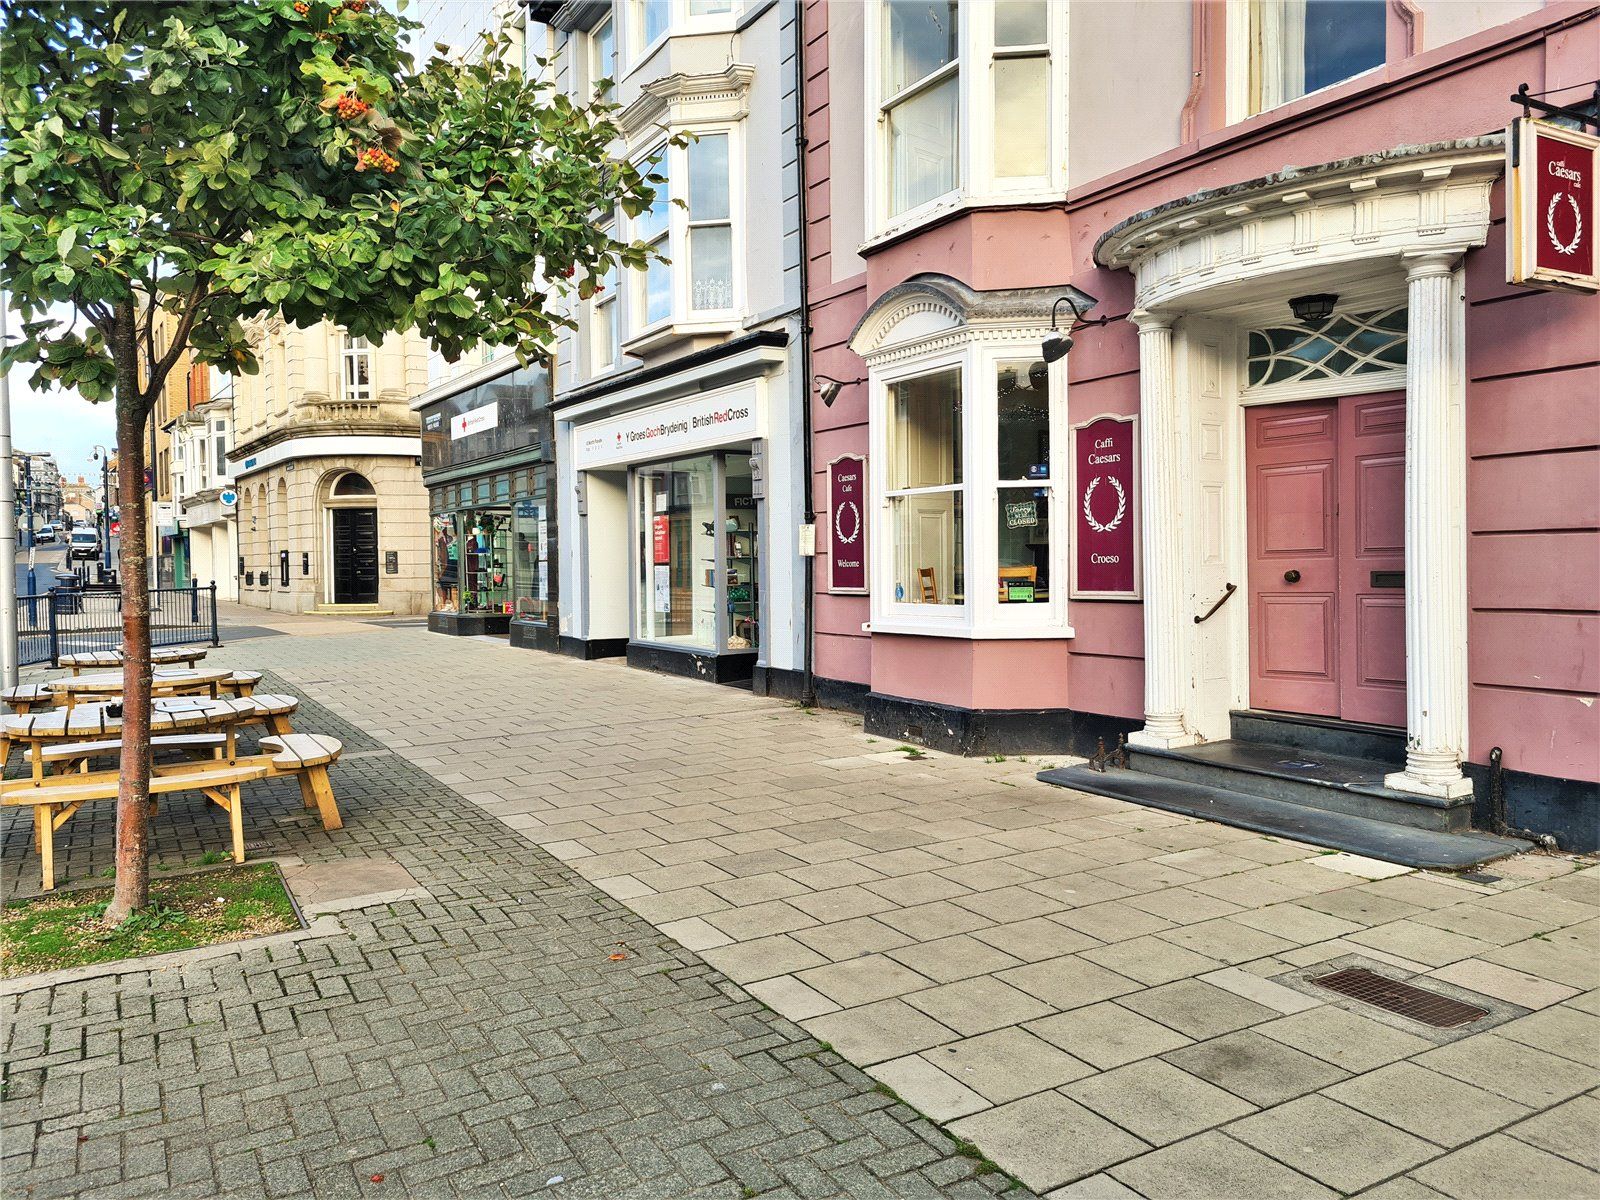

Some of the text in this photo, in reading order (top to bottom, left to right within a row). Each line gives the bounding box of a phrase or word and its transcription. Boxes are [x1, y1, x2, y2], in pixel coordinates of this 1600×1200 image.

[1548, 160, 1581, 181] Caesars
[625, 431, 630, 442] Y
[1094, 437, 1114, 449] Caffi
[1088, 453, 1121, 465] Caesars
[837, 473, 857, 483] Caesars
[841, 484, 853, 493] Cafe
[1009, 517, 1035, 526] CLOSED
[837, 559, 860, 568] Welcome
[1090, 552, 1120, 564] Croeso
